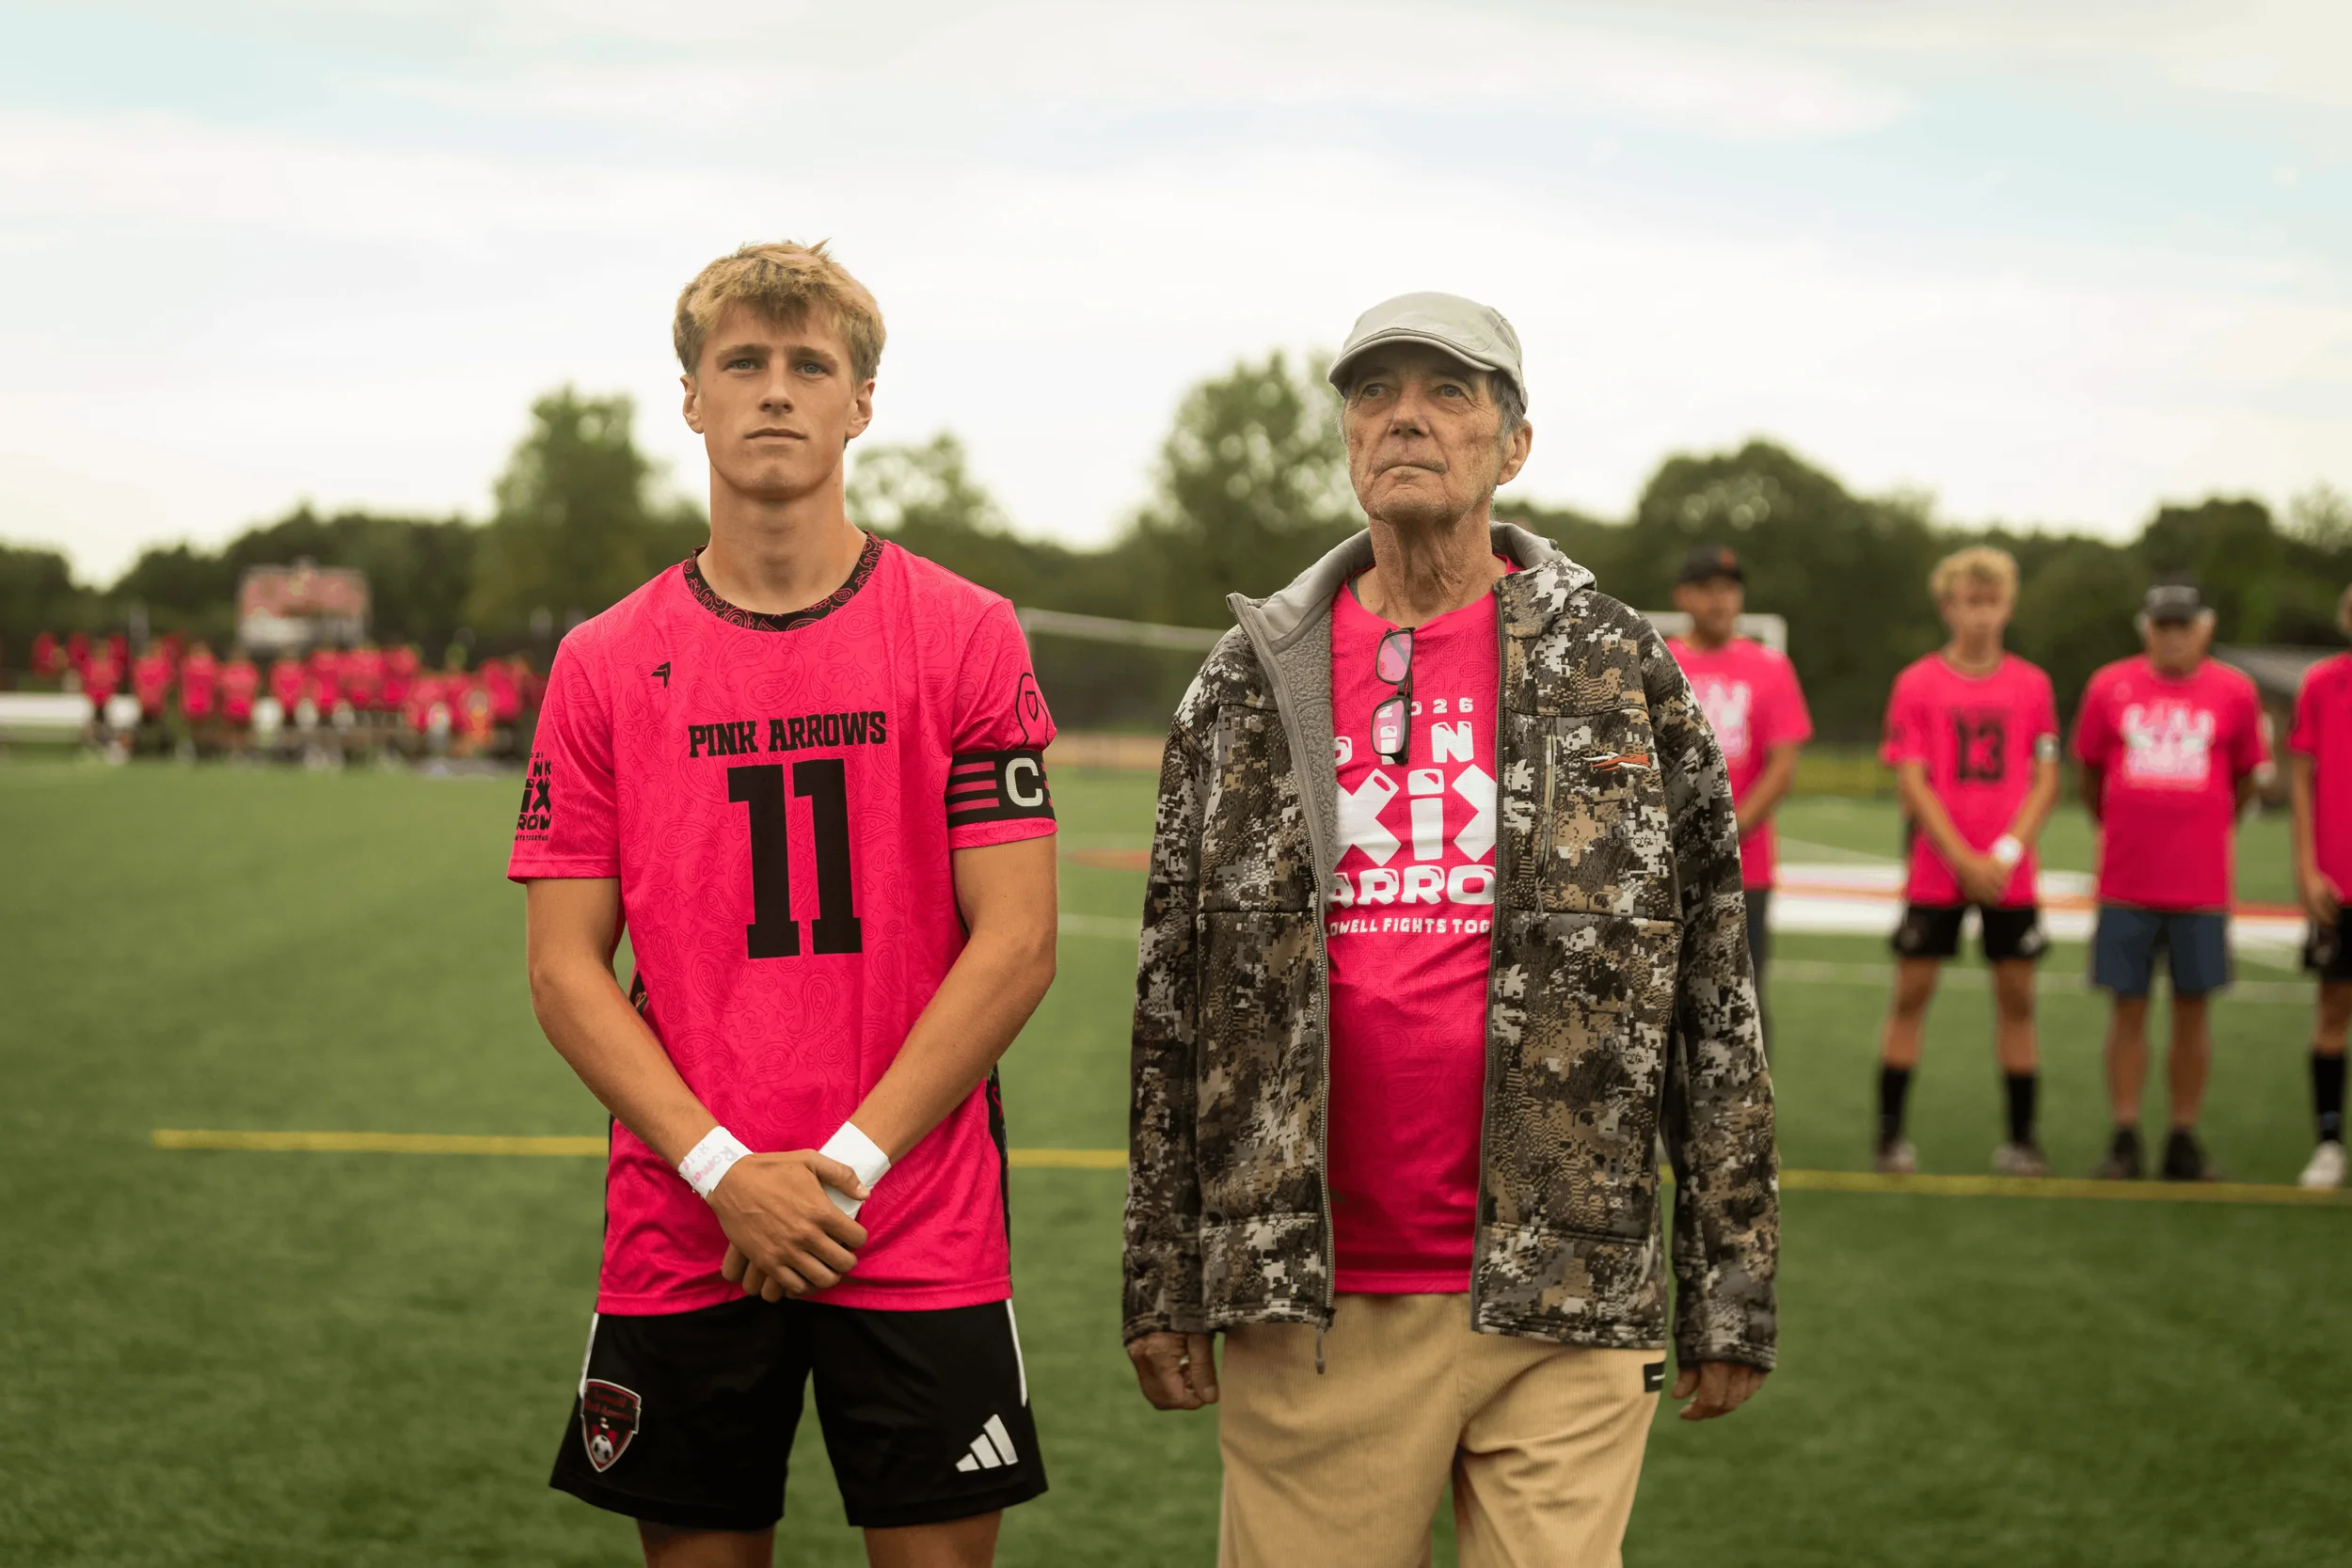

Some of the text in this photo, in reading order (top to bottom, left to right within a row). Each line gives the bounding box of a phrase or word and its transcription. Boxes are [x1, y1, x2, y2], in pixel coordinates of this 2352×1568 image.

[1378, 698, 1474, 719] 2026
[688, 711, 886, 758] PINK ARROWS
[1005, 757, 1044, 807] C
[516, 814, 552, 831] ROW
[727, 758, 863, 959] 11
[1325, 919, 1378, 937] OWELL
[1453, 919, 1490, 934] TOG
